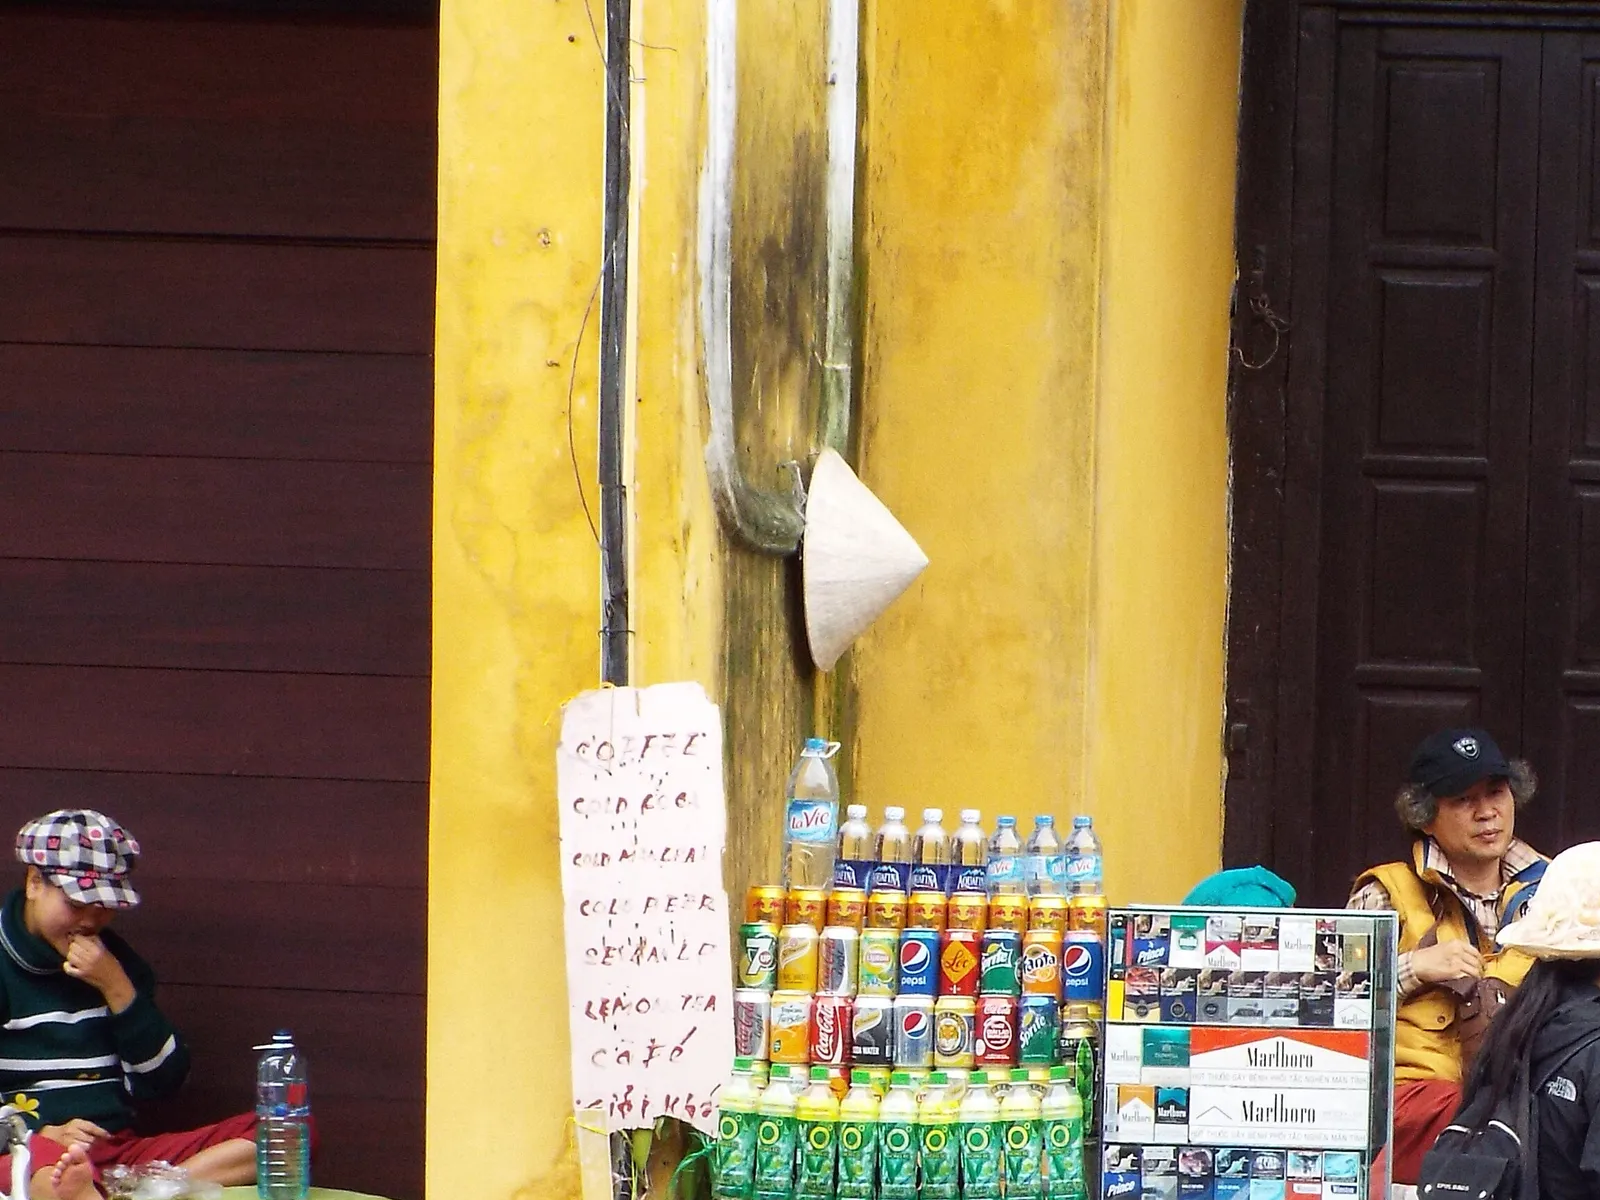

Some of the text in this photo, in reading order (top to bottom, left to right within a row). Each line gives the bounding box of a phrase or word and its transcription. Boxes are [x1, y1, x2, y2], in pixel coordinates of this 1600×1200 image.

[901, 976, 927, 986] pepsi
[1066, 976, 1089, 986] pepsi
[1247, 1041, 1313, 1068] Marlboro
[1242, 1094, 1316, 1124] Marlboro
